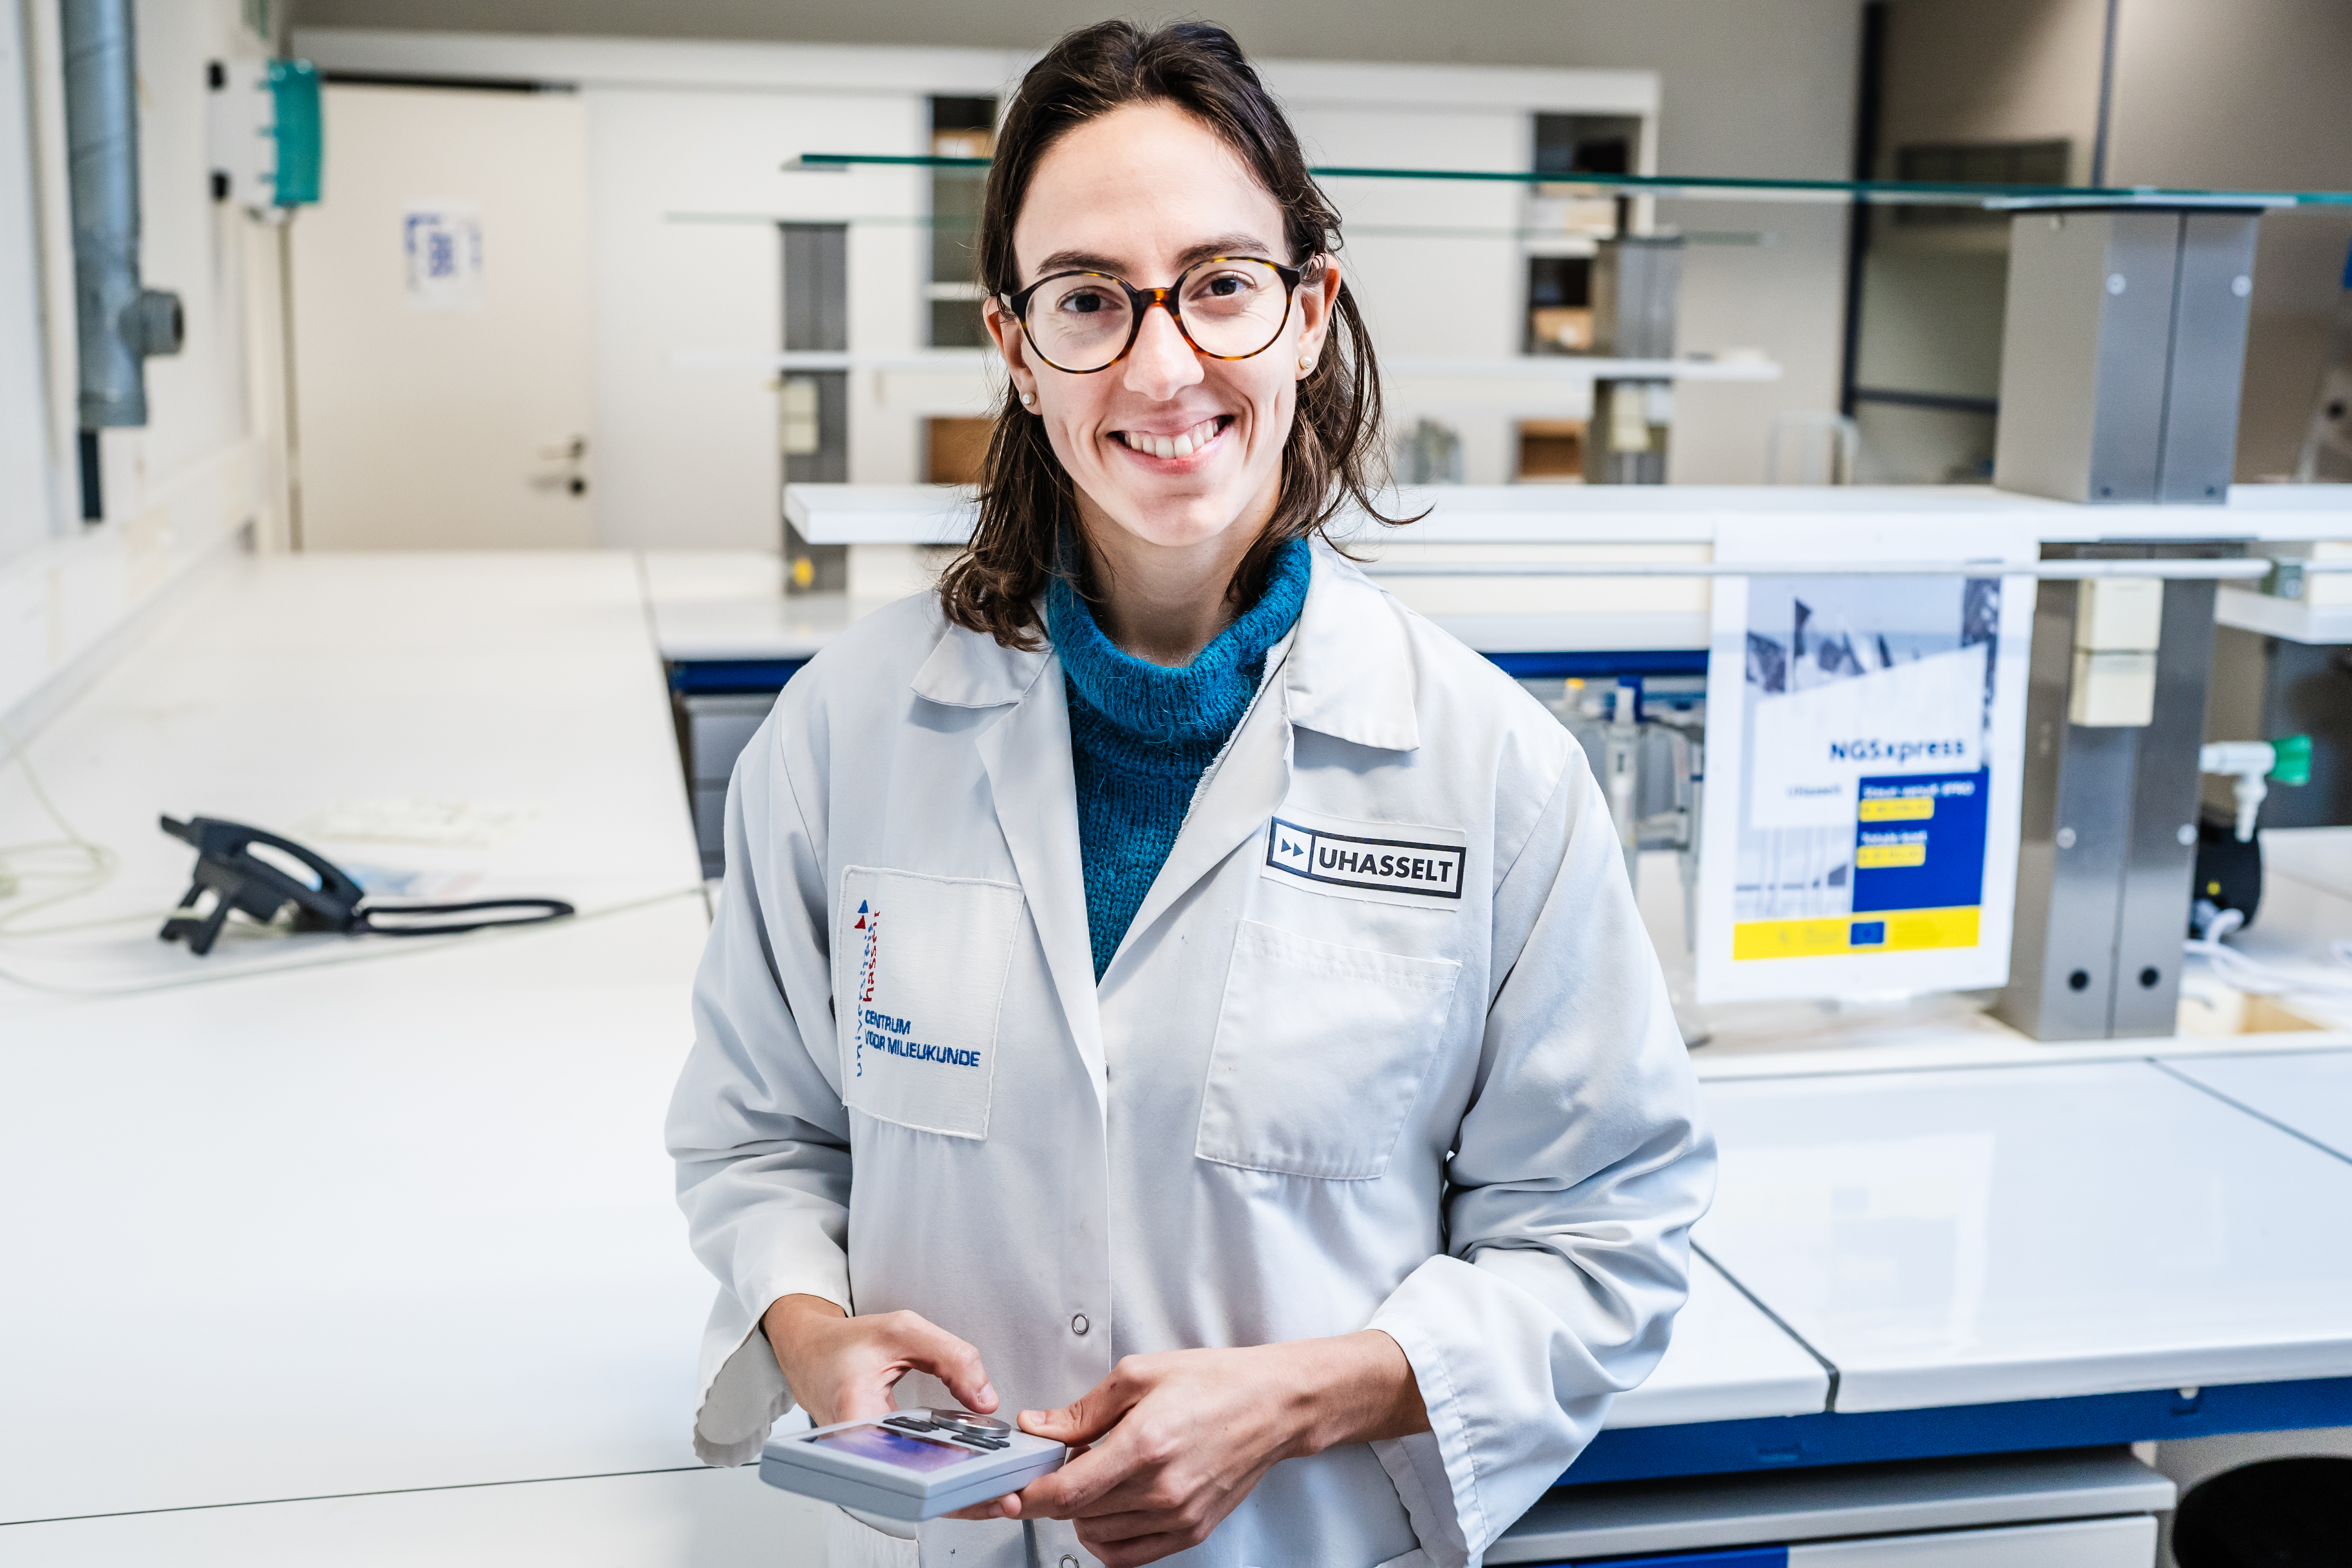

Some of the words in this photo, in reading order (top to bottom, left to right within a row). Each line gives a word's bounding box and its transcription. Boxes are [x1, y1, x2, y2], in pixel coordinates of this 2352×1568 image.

[1830, 739, 1965, 764] NGSxpress
[1319, 847, 1453, 882] UHASSELT
[865, 1009, 911, 1035] CENTRUM
[865, 1028, 885, 1051] VOOR
[887, 1037, 981, 1067] MILIEUKUNDE
